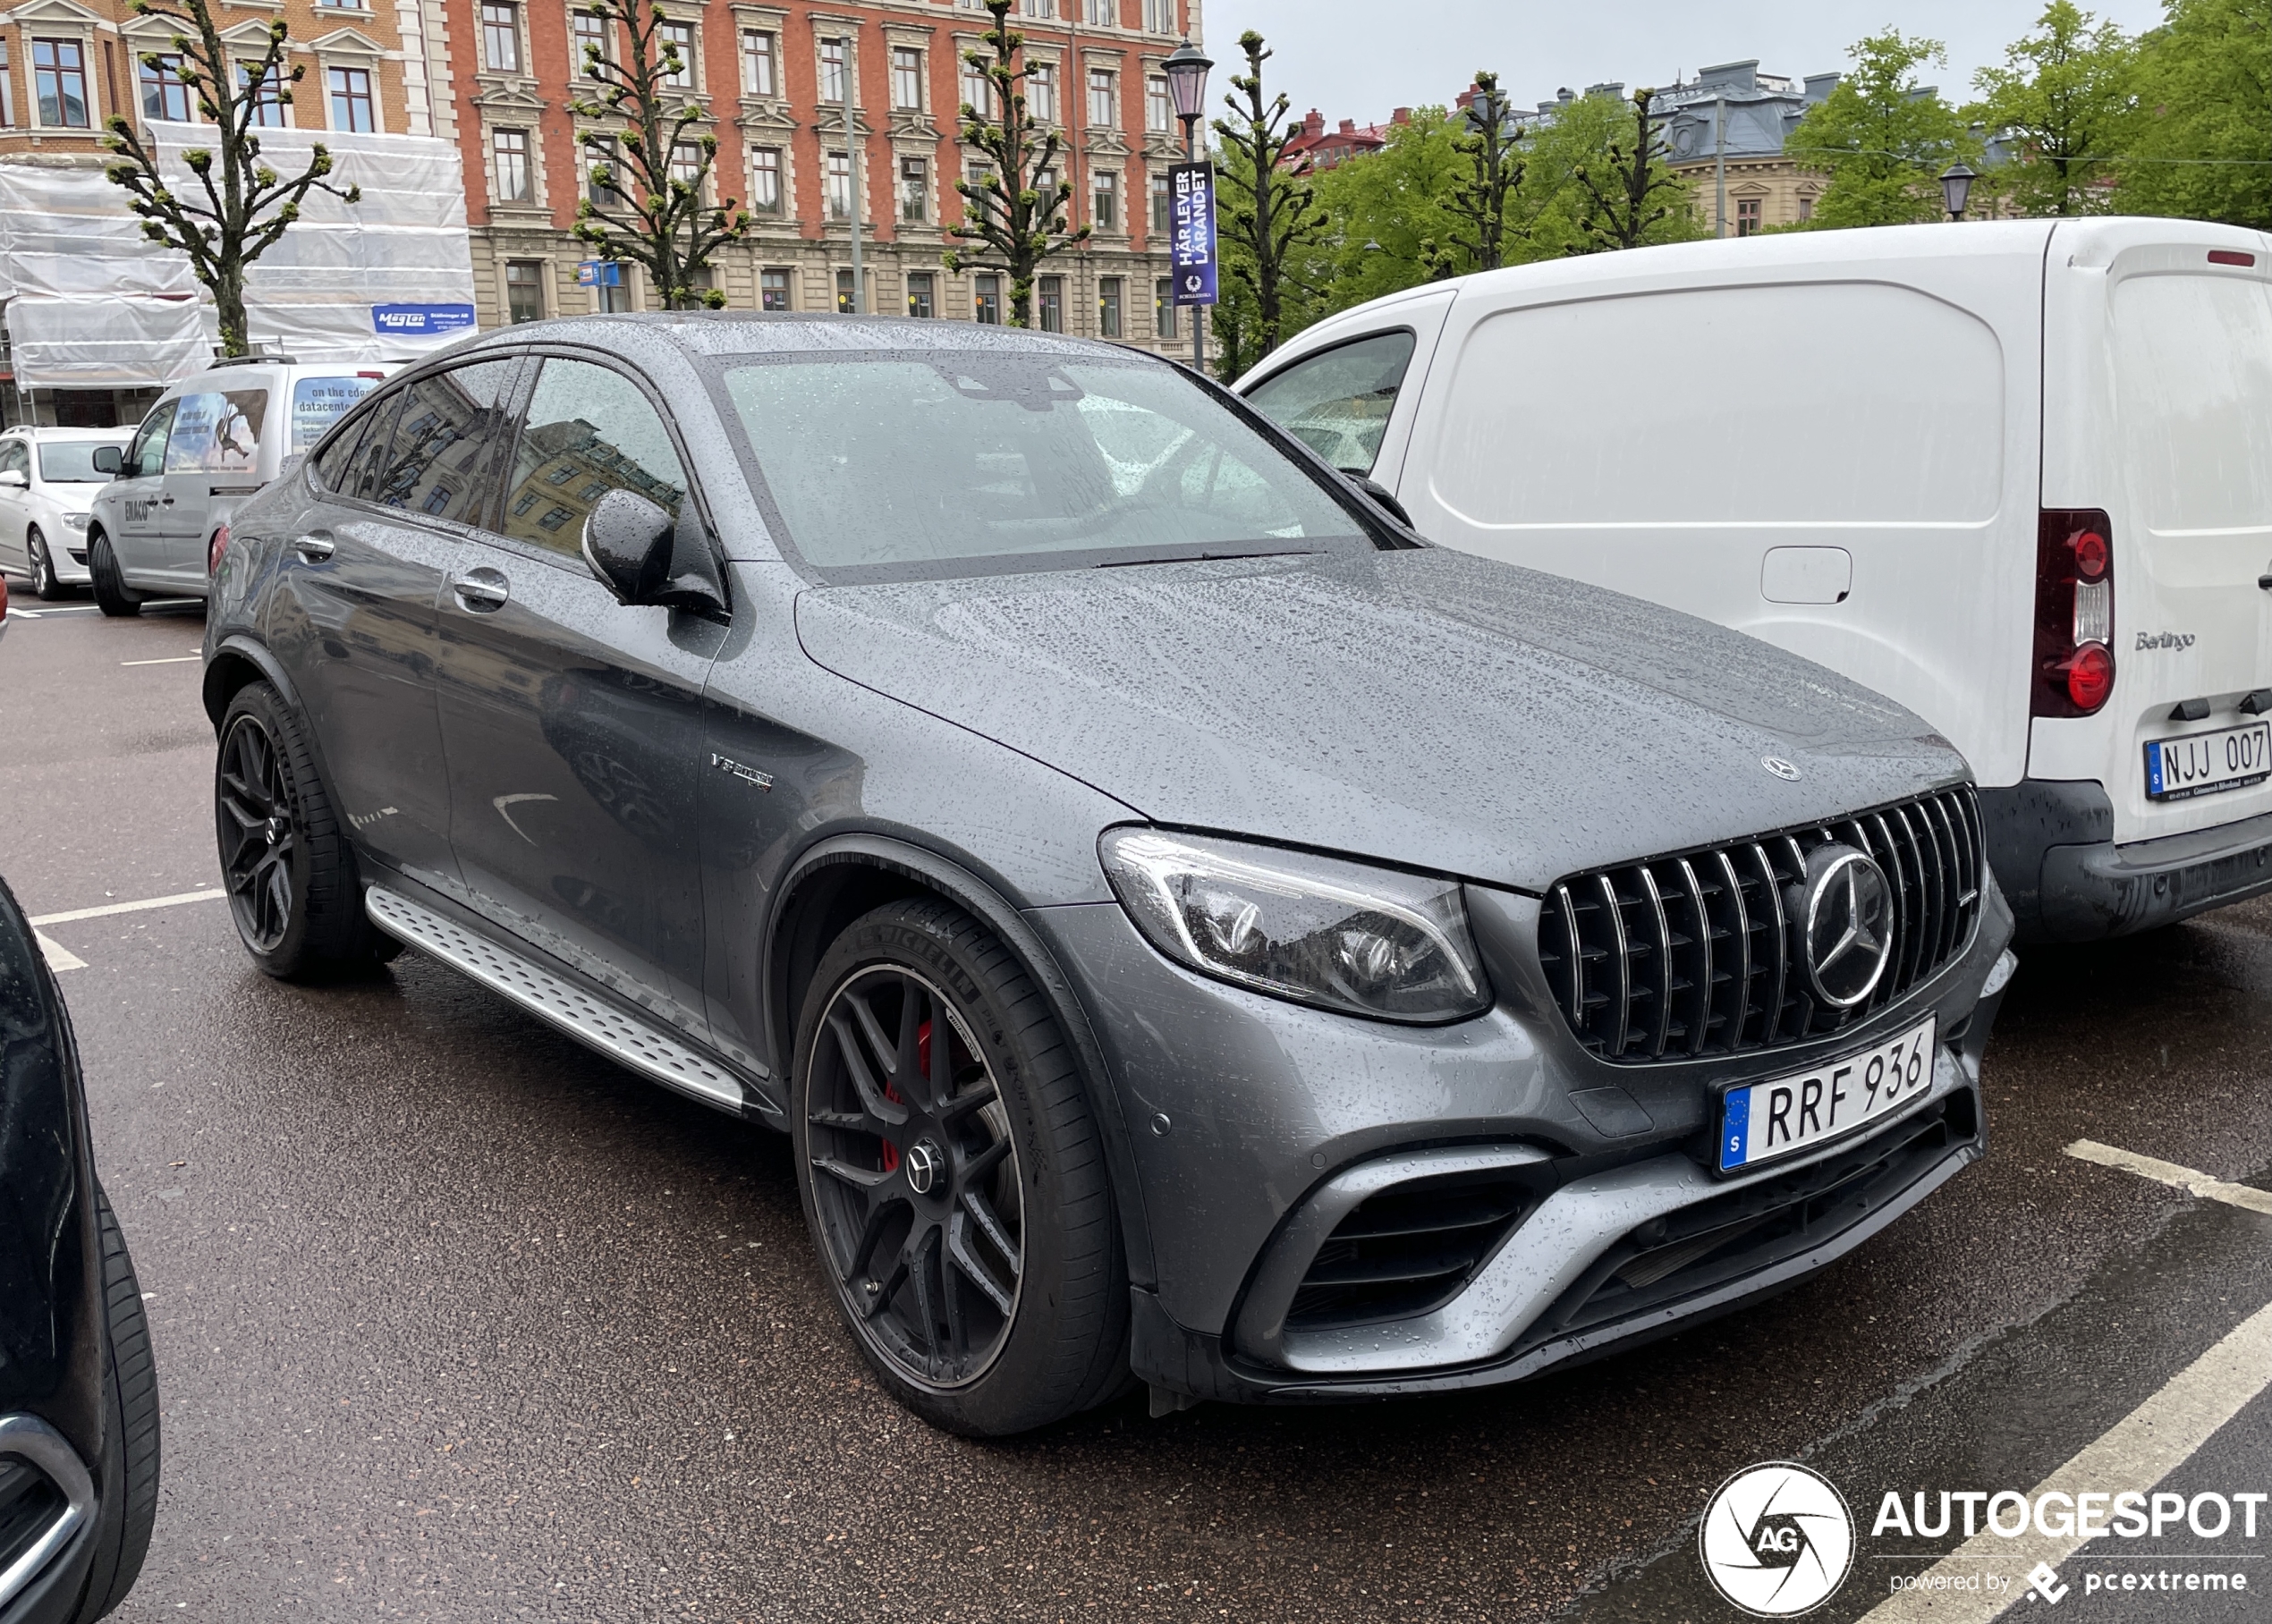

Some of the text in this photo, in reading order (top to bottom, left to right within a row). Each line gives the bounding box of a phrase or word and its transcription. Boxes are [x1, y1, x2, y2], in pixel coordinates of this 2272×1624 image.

[1175, 170, 1193, 266] HÄR LEVER
[1191, 170, 1208, 265] LÄRANDET
[312, 388, 325, 398] on
[327, 386, 345, 398] the
[2135, 631, 2195, 652] Berlingo
[2153, 774, 2159, 784] S
[2165, 730, 2263, 785] NJJ 007
[878, 925, 975, 996] MICHELIN
[1765, 1031, 1923, 1147] RRF 936
[1730, 1135, 1740, 1153] S
